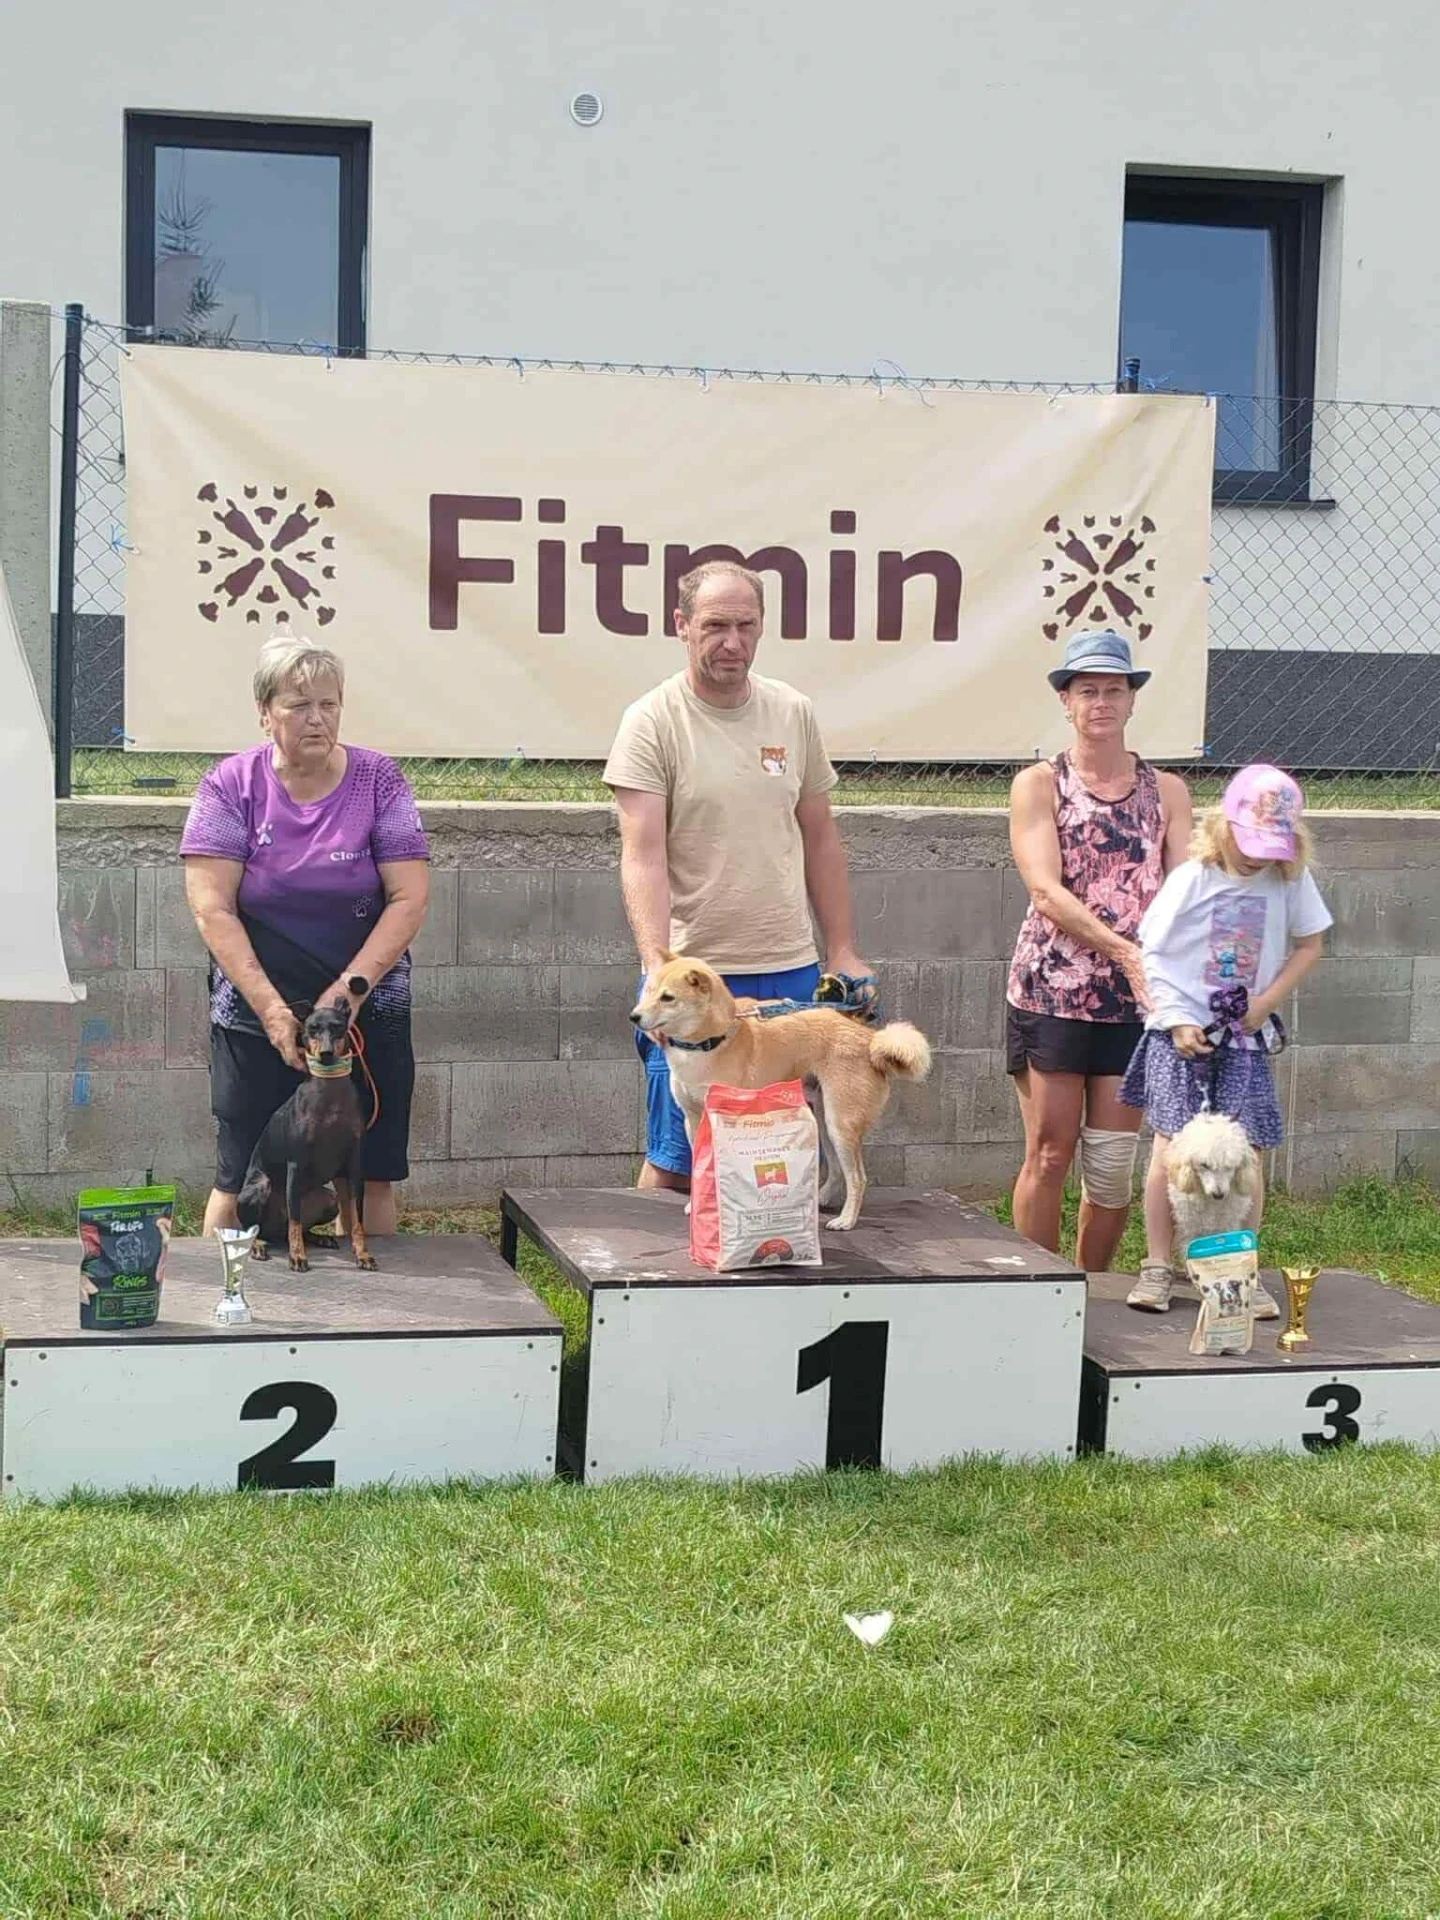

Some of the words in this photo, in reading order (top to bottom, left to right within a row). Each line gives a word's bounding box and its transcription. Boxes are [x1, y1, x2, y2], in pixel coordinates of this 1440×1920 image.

[429, 493, 963, 642] Fitmin
[237, 1380, 338, 1490] 2
[796, 1320, 890, 1473] 1
[1301, 1383, 1362, 1456] 3
